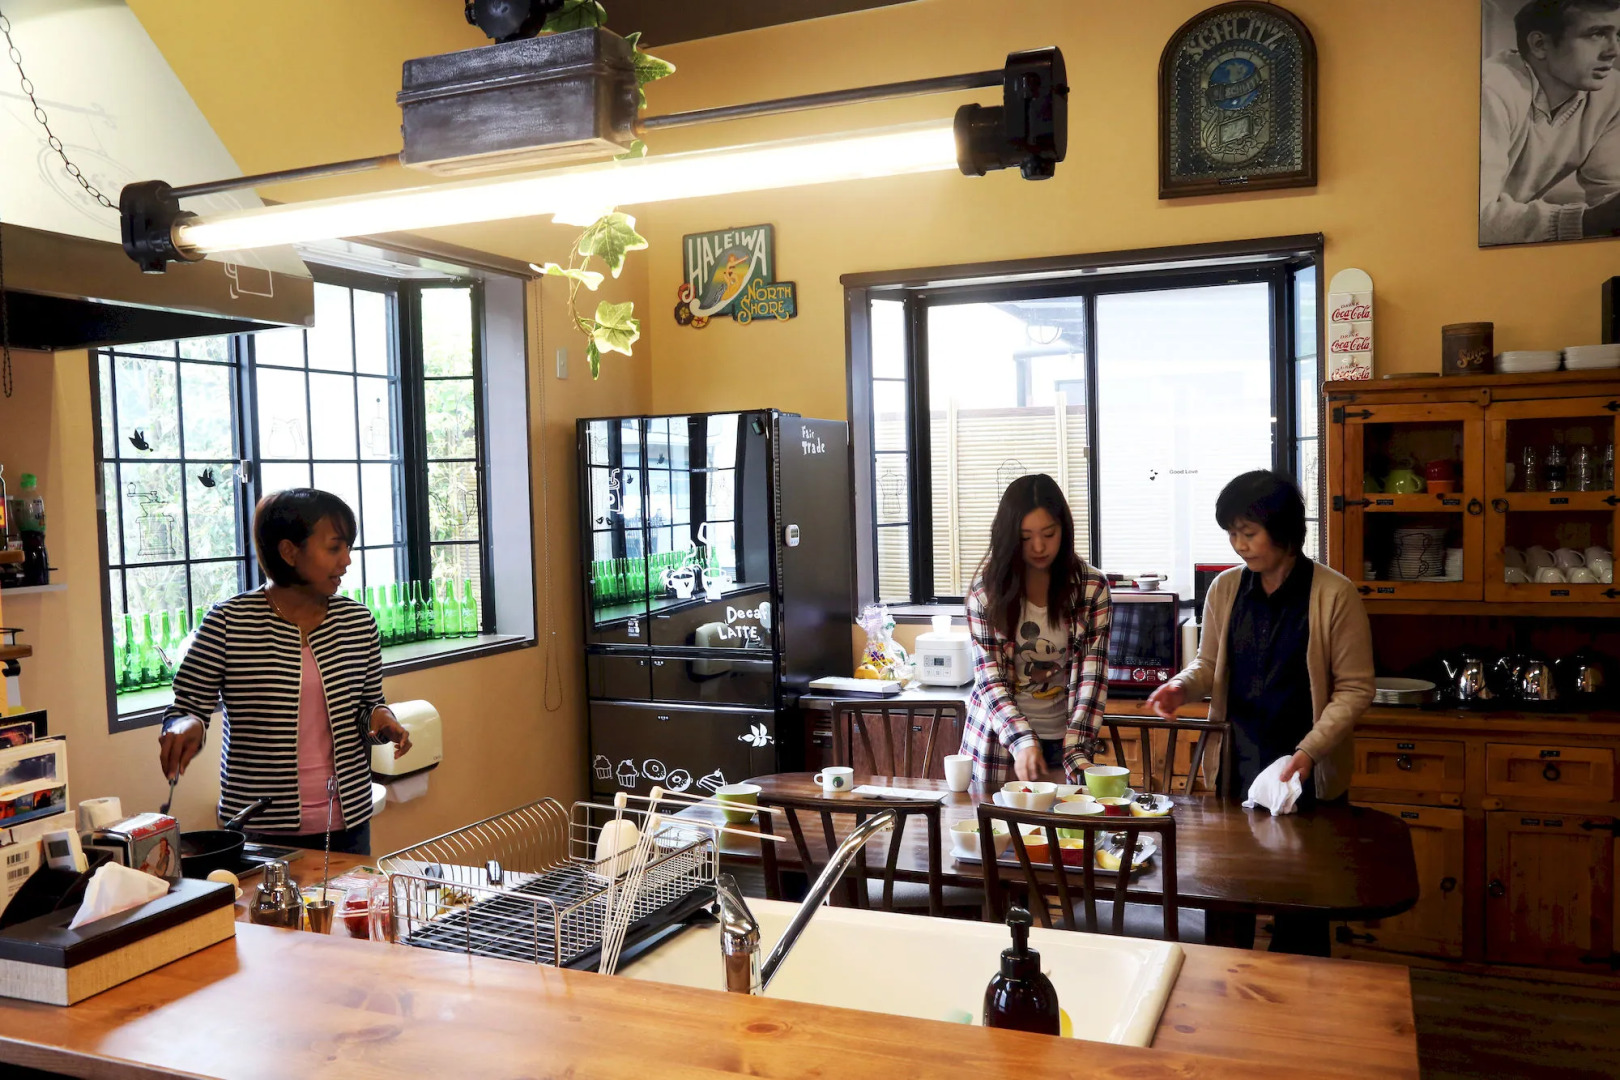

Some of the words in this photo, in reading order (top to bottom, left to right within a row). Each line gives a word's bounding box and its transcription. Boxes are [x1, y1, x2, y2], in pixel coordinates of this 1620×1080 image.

[1186, 18, 1286, 60] SCHLITZ
[681, 228, 767, 304] HALEIWA
[747, 278, 791, 301] NORTH
[738, 294, 789, 324] SHORE
[801, 425, 815, 439] Fair
[801, 437, 825, 455] Trade
[726, 606, 768, 624] Decaf
[717, 625, 757, 640] LATTE
